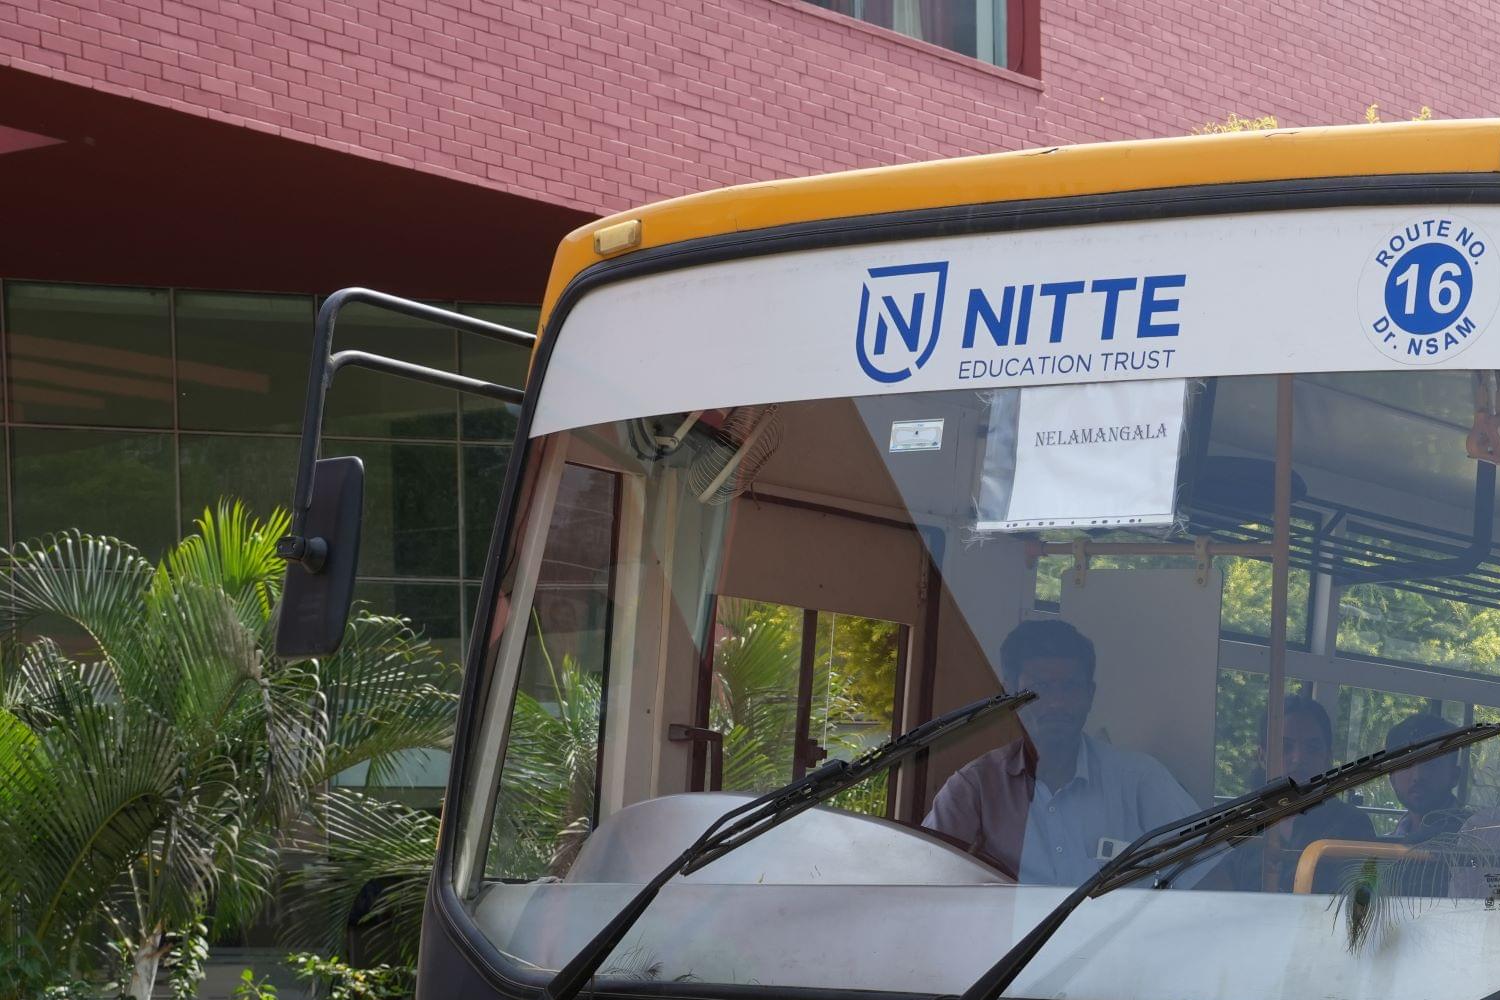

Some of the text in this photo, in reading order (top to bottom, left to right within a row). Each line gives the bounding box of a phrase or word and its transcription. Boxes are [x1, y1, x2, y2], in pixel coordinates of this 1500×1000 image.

[1375, 219, 1486, 268] ROUTE NO.
[961, 273, 1187, 349] NITTE
[1395, 262, 1463, 315] 16
[1372, 315, 1477, 356] Dr. NSAM
[957, 349, 1176, 380] EDUCATION TRUST
[1034, 422, 1168, 447] NELAMANGALA
